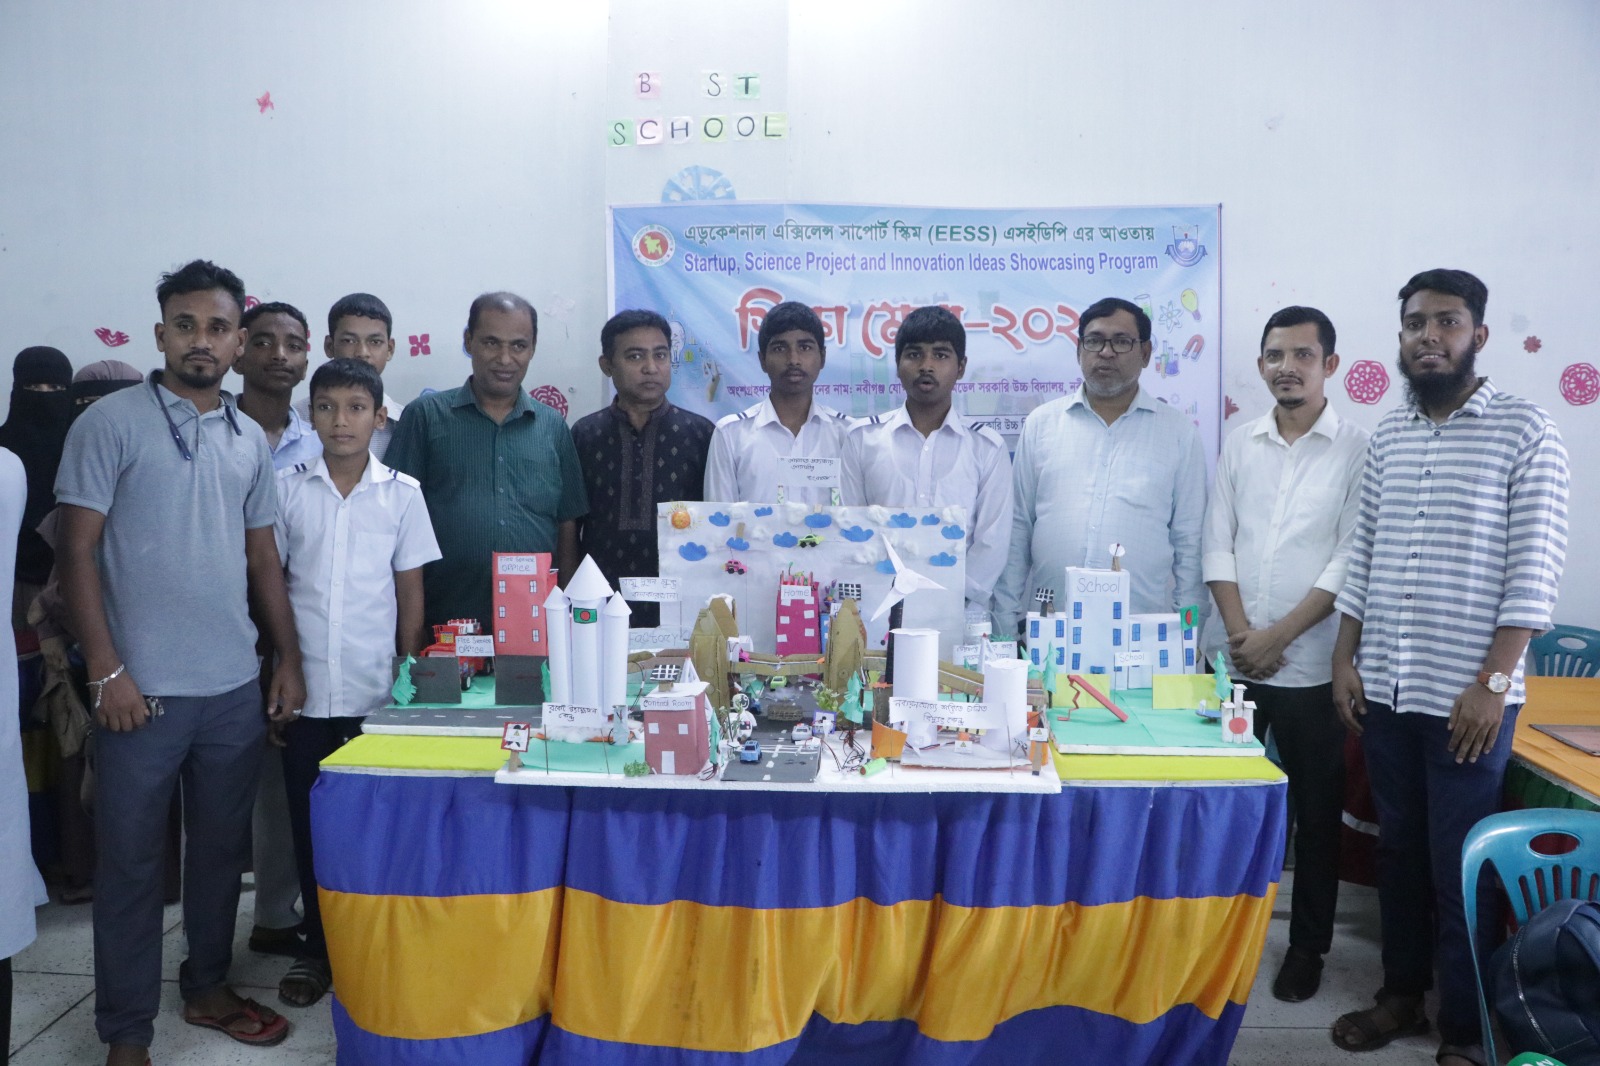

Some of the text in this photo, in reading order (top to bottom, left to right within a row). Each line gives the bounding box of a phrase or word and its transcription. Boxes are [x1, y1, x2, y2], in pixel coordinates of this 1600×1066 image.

[612, 115, 783, 146] SCHOOL
[684, 223, 767, 247] এডুকেশনাল
[838, 219, 890, 242] সাপোর্ট
[892, 219, 923, 242] স্কিম
[927, 224, 998, 246] (EESS)
[1003, 221, 1068, 244] এসইডিপি
[1072, 226, 1095, 242] এর
[1098, 224, 1156, 243] আওতায়
[684, 251, 1158, 276] Startup, Science Project and Innovation Ideas Showcasing Program
[977, 378, 1010, 393] সরকারি
[1011, 378, 1029, 393] উচ্চ
[783, 589, 810, 597] Home
[1077, 576, 1120, 594] School
